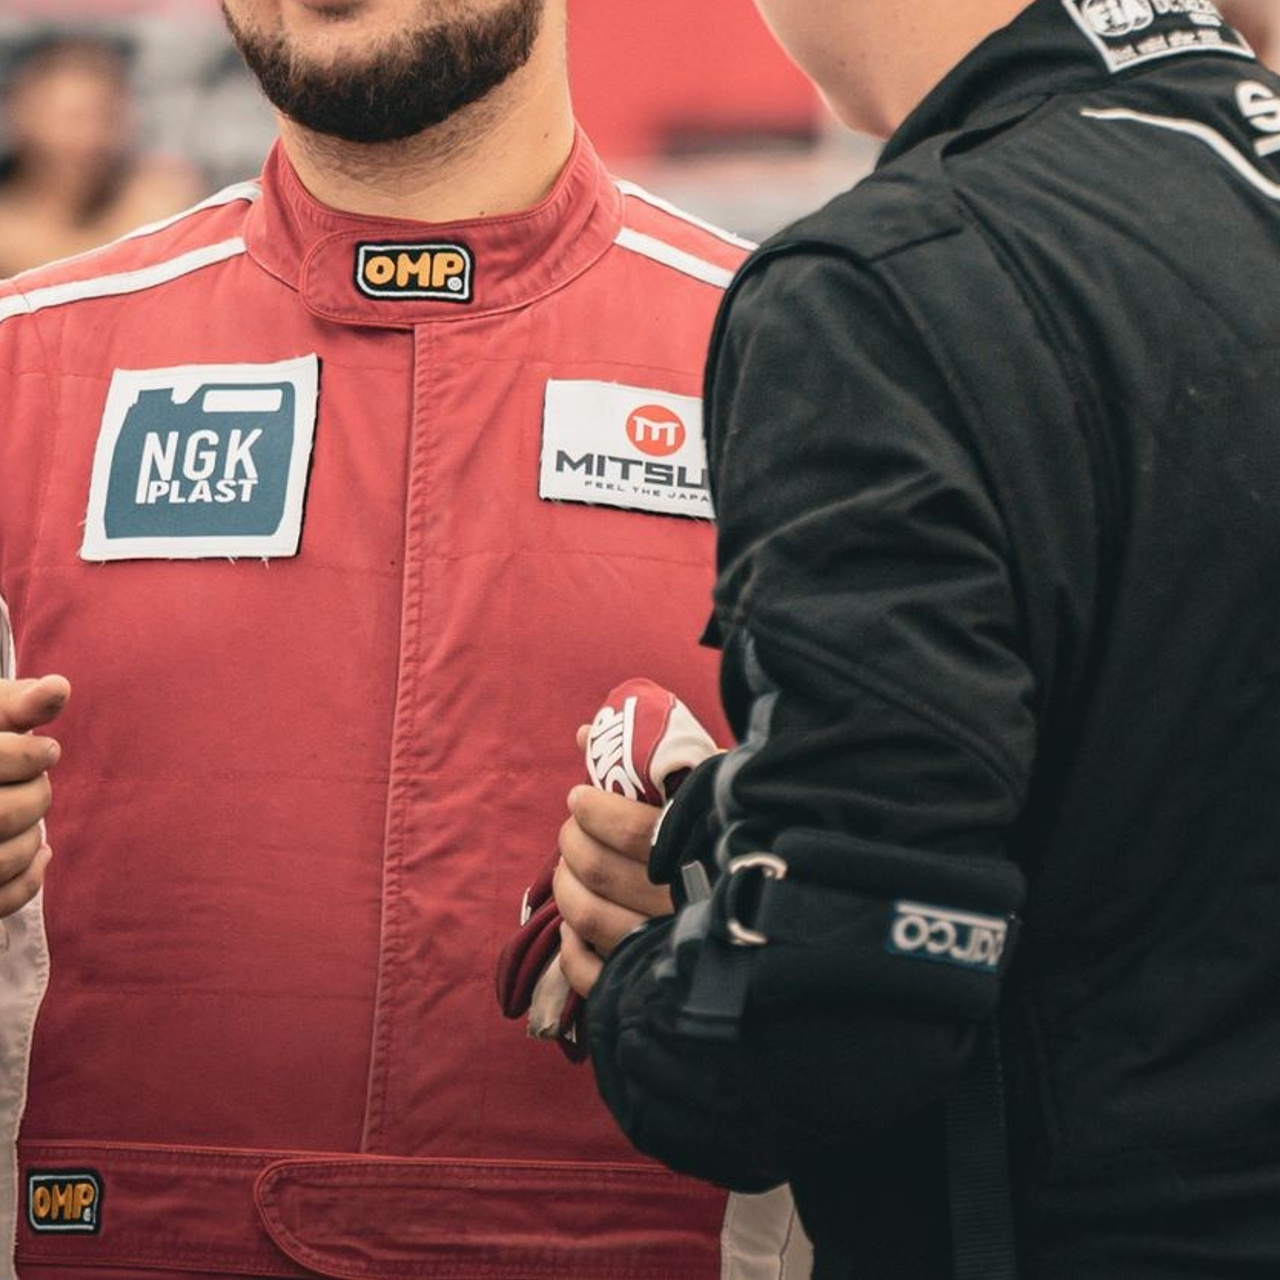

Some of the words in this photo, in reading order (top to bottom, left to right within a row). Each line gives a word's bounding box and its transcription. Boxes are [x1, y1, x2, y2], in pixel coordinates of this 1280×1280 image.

[135, 428, 263, 504] NGK
[555, 449, 710, 490] MITSU
[147, 479, 258, 504] PLAST
[632, 487, 661, 497] THE
[33, 1183, 95, 1221] OMP
